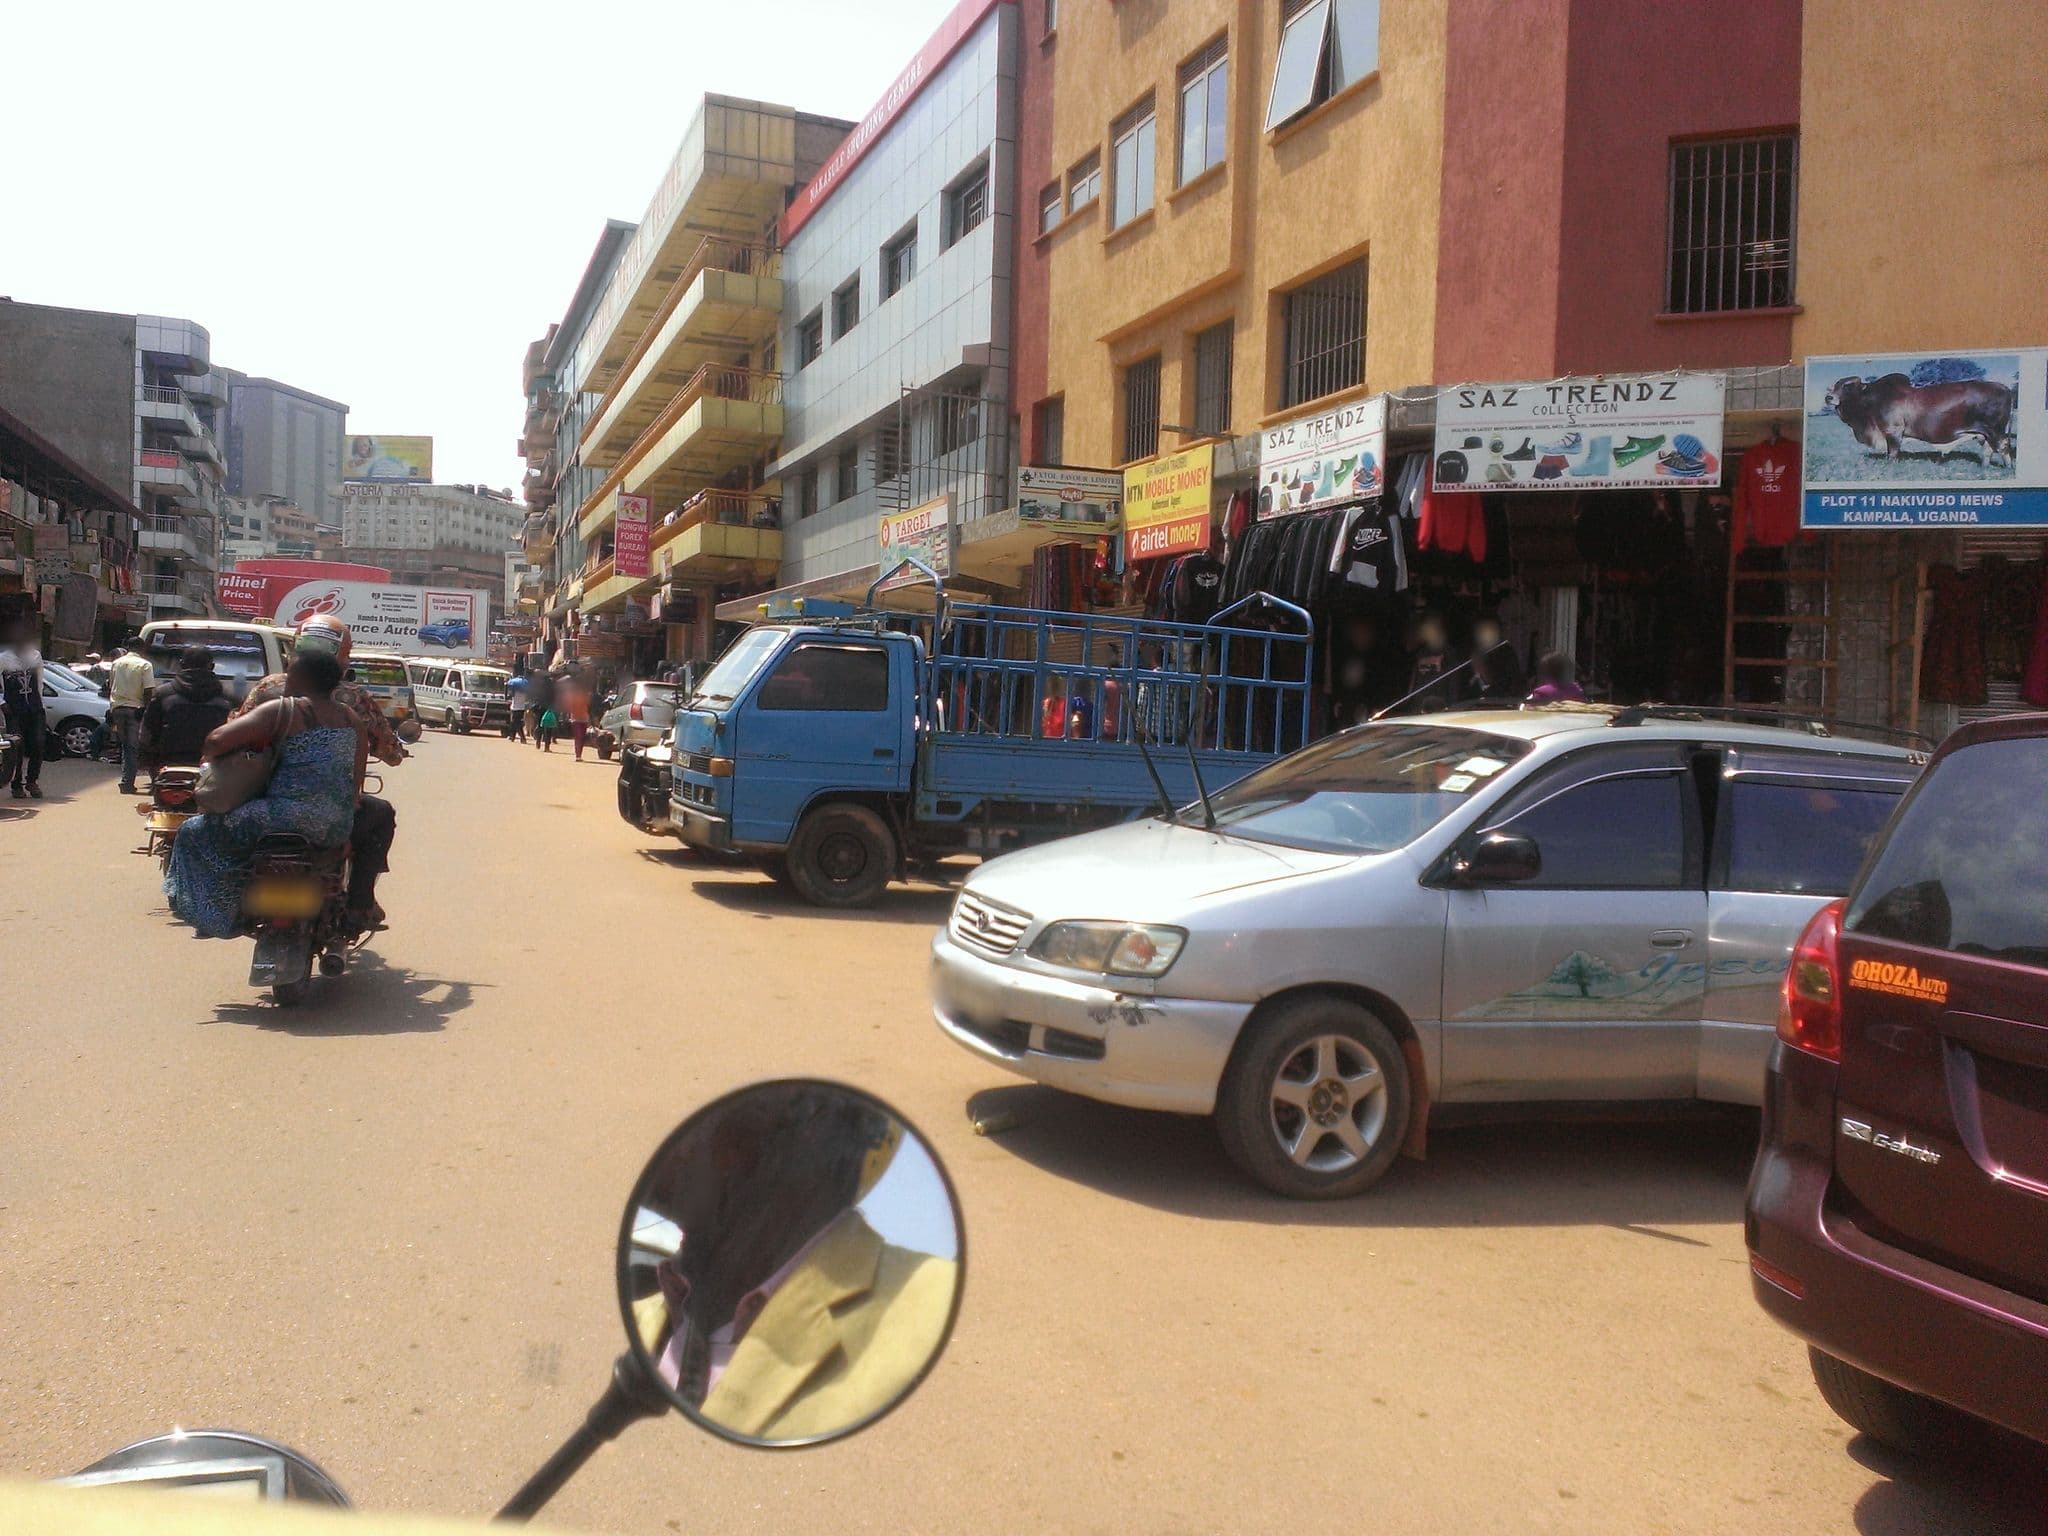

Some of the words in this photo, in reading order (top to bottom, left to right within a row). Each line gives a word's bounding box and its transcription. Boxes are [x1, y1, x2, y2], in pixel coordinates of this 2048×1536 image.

[887, 55, 923, 111] CENTRE
[1459, 389, 1518, 408] SAZ
[1545, 381, 1678, 404] TRENDZ
[1532, 404, 1618, 416] COLLECTION
[1269, 429, 1295, 449] SAZ
[1306, 406, 1365, 438] TRENDZ
[1127, 484, 1143, 503] MTN
[1145, 475, 1175, 499] MOBILE
[1177, 466, 1208, 492] MONEY
[391, 486, 423, 497] HOTEL
[1821, 495, 1857, 507] PLOT
[1860, 495, 1876, 507] 11
[1881, 495, 1956, 506] NAKIVUBO
[1960, 495, 2004, 506] MEWS
[1843, 512, 1914, 524] KAMPALA,
[1918, 511, 1979, 523] UGANDA
[896, 512, 932, 537] TARGET
[620, 532, 643, 541] FOREX
[1141, 526, 1169, 552] airtel
[1170, 522, 1202, 546] money
[619, 542, 646, 551] BUREAU
[219, 575, 267, 589] nline!
[223, 589, 254, 599] Price.
[383, 624, 417, 636] Auto
[1920, 977, 1947, 994] AUTO
